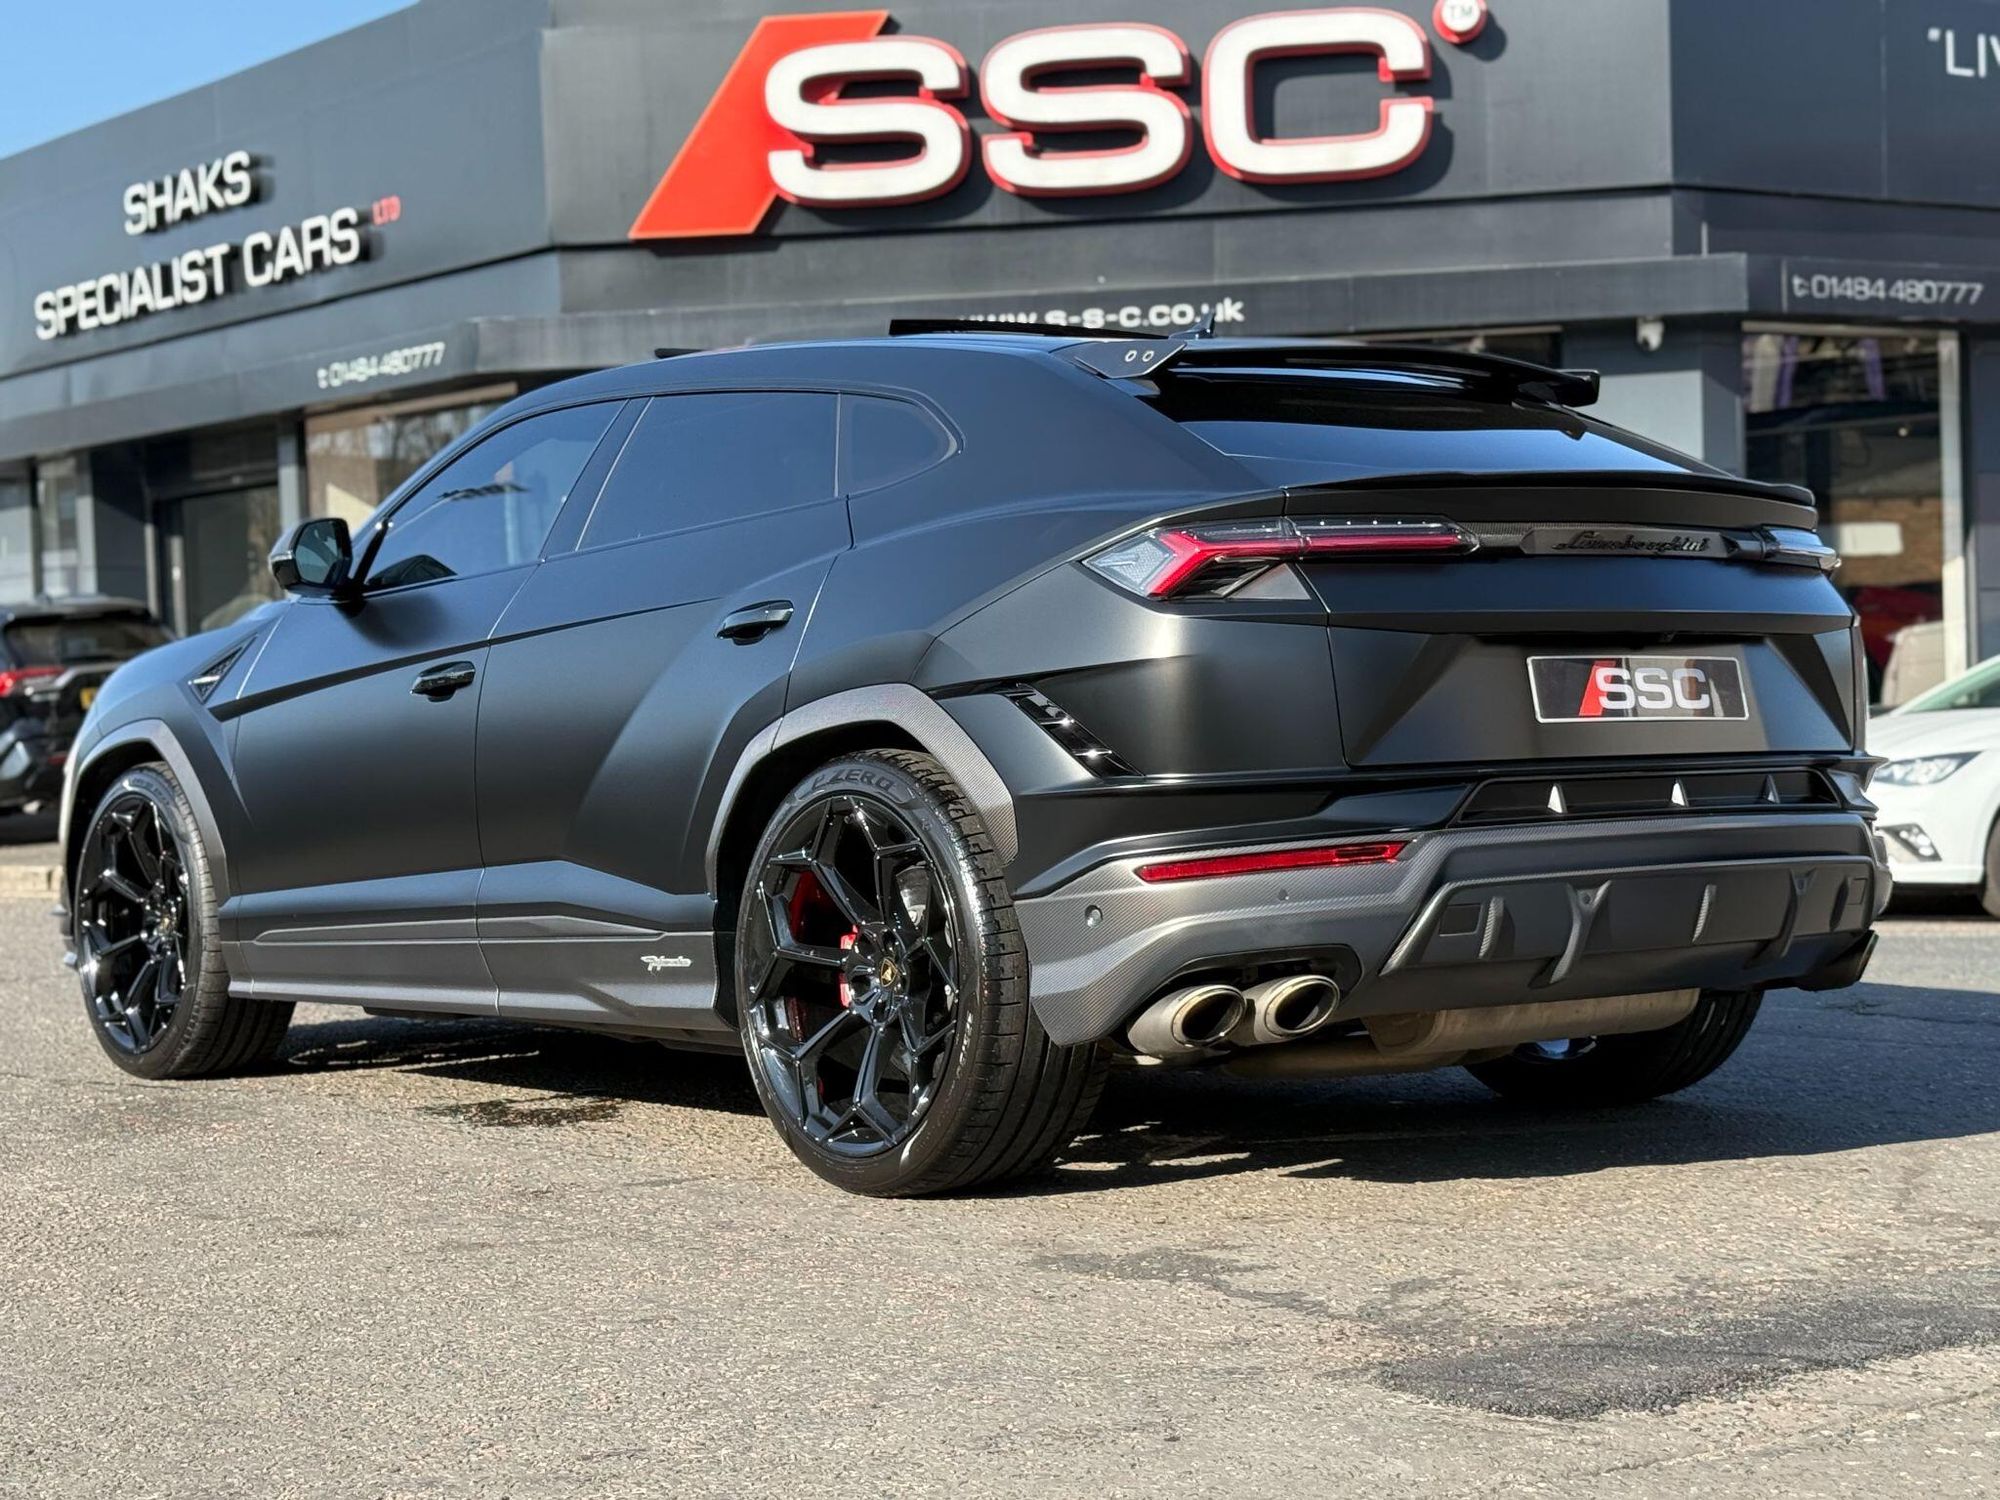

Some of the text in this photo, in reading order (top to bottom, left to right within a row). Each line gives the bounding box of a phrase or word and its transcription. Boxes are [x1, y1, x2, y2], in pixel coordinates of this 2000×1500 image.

[1449, 4, 1474, 19] TM
[764, 8, 1434, 207] SSC
[123, 151, 250, 235] SHAKS
[35, 195, 401, 340] SPECIALIST CARS LTD
[1595, 667, 1710, 710] SSC
